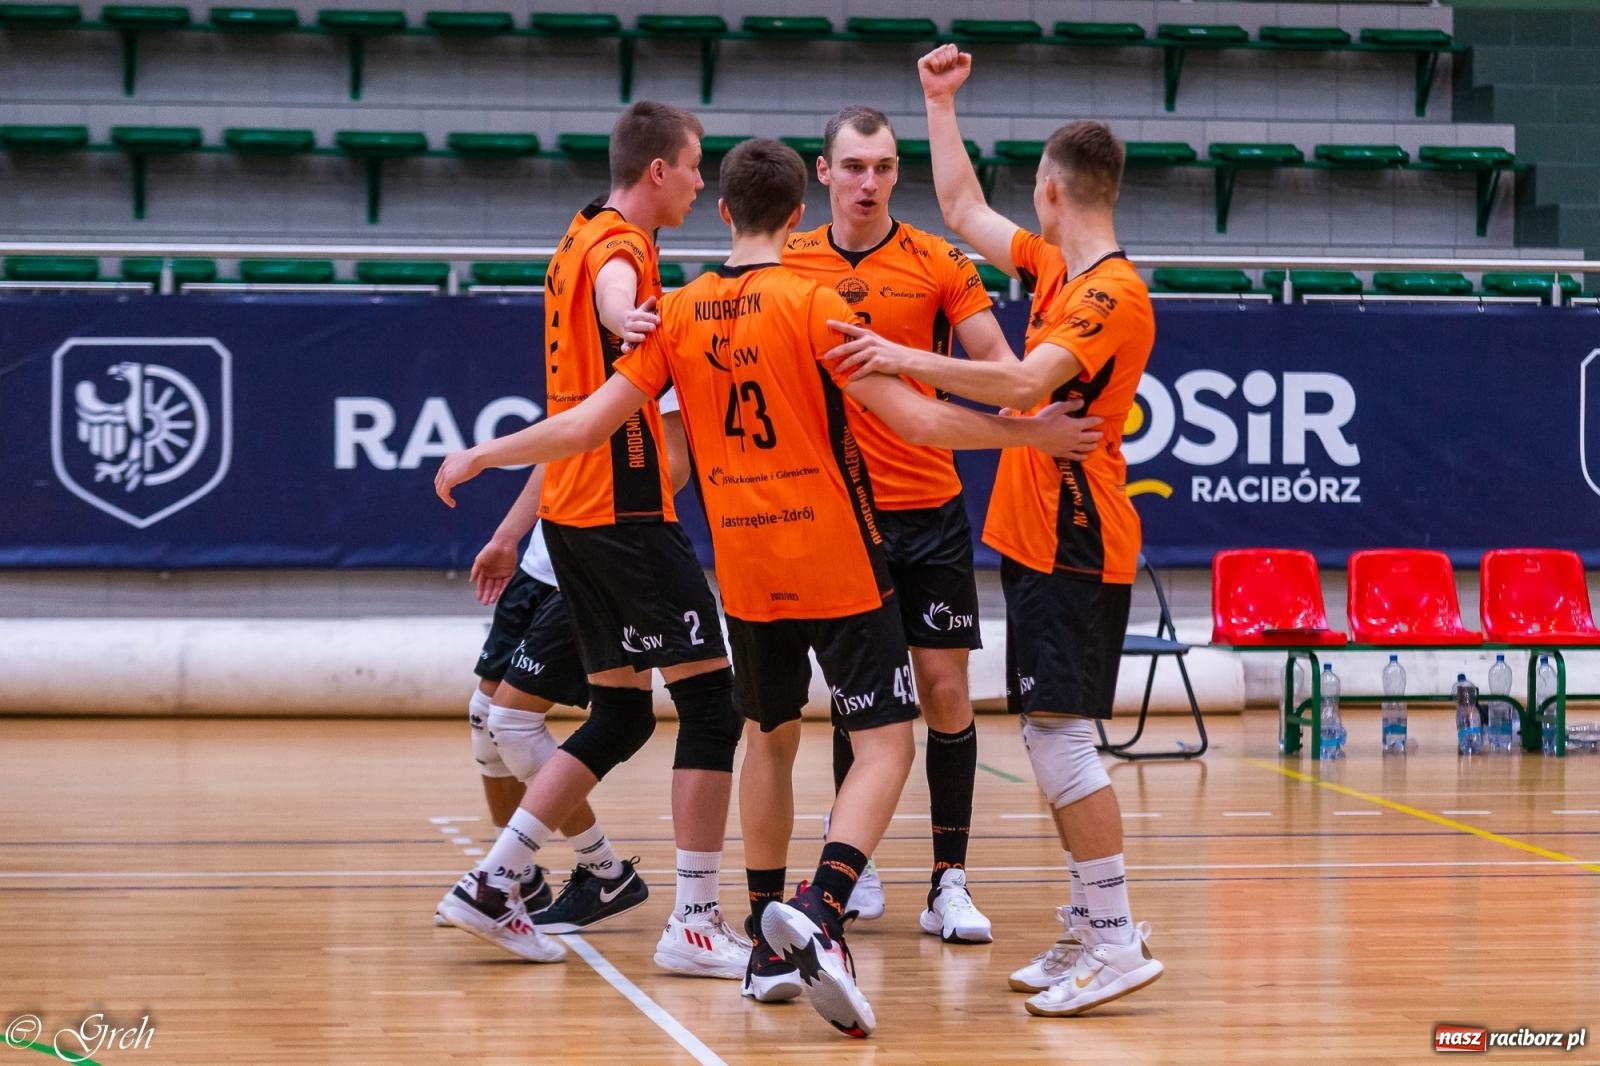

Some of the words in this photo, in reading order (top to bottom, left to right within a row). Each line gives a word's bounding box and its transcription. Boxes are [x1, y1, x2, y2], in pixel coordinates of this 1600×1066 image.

[732, 346, 759, 368] SW
[724, 380, 777, 450] 43
[776, 467, 820, 479] Górnictwo
[1191, 470, 1361, 503] RACIBÓRZ
[721, 506, 815, 529] Jastrzębie-Zdrój
[683, 610, 704, 646] 2
[893, 664, 915, 705] 43
